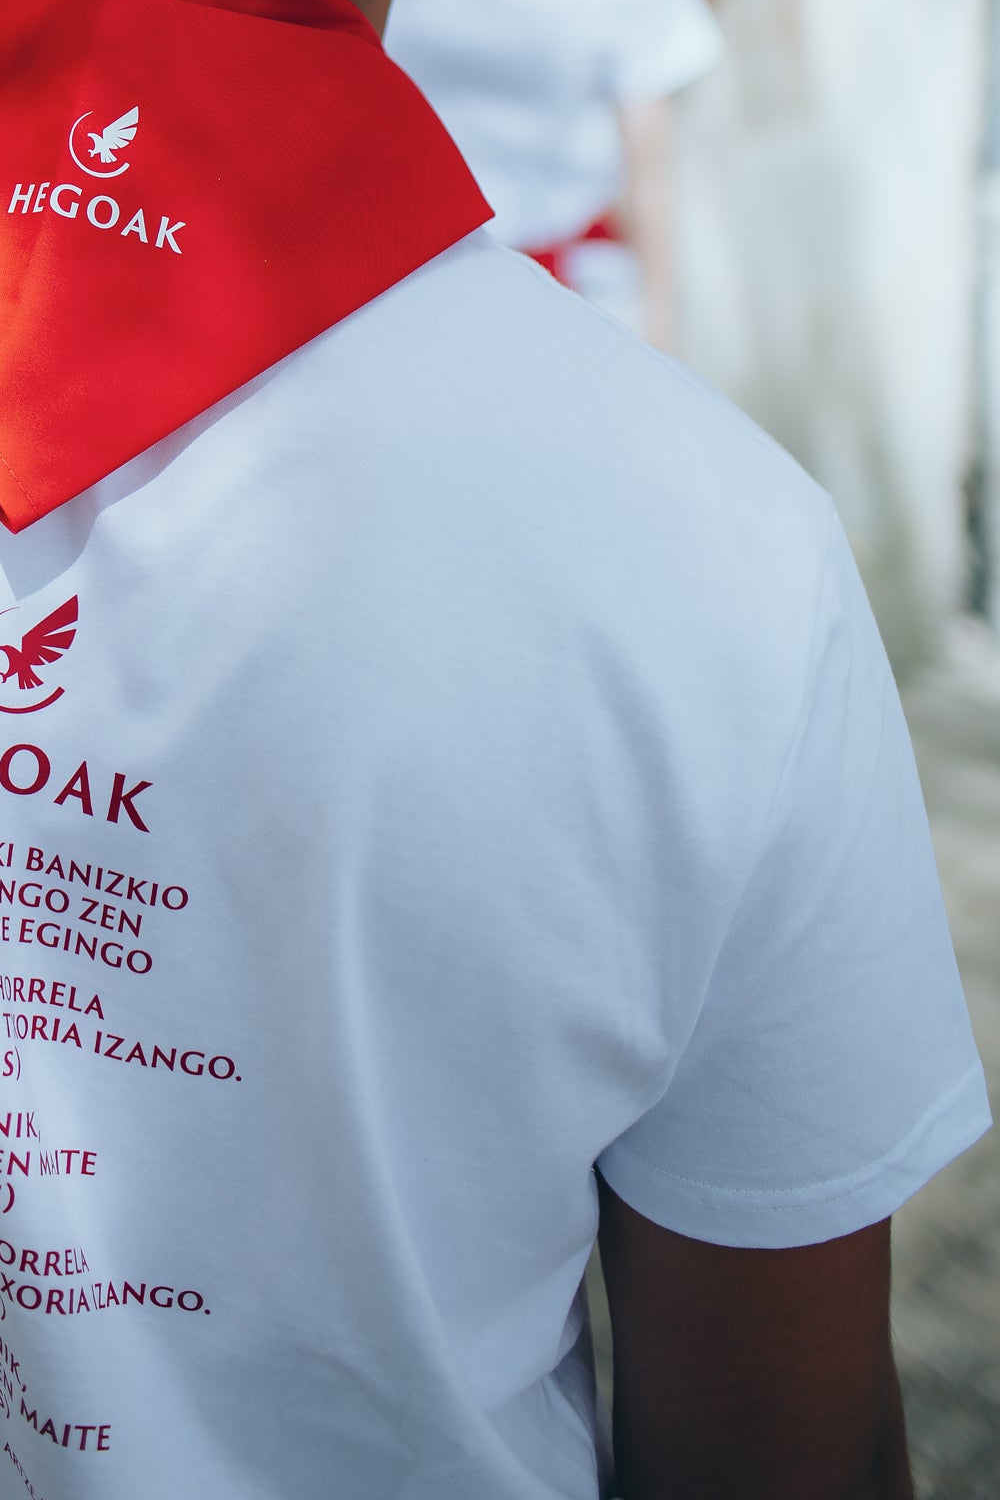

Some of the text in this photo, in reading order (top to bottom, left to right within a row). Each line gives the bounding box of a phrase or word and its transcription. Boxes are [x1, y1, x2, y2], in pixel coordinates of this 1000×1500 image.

[8, 182, 187, 254] HEGOAK
[26, 846, 189, 911] BANIZKIO
[79, 897, 142, 938] ZEN
[19, 918, 153, 975] EGINGO
[2, 1012, 83, 1049] TXORIA
[93, 1030, 242, 1082] IZANGO.
[39, 1149, 98, 1177] MAITE
[91, 1280, 211, 1315] IZANGO.
[20, 1396, 112, 1451] MAITE
